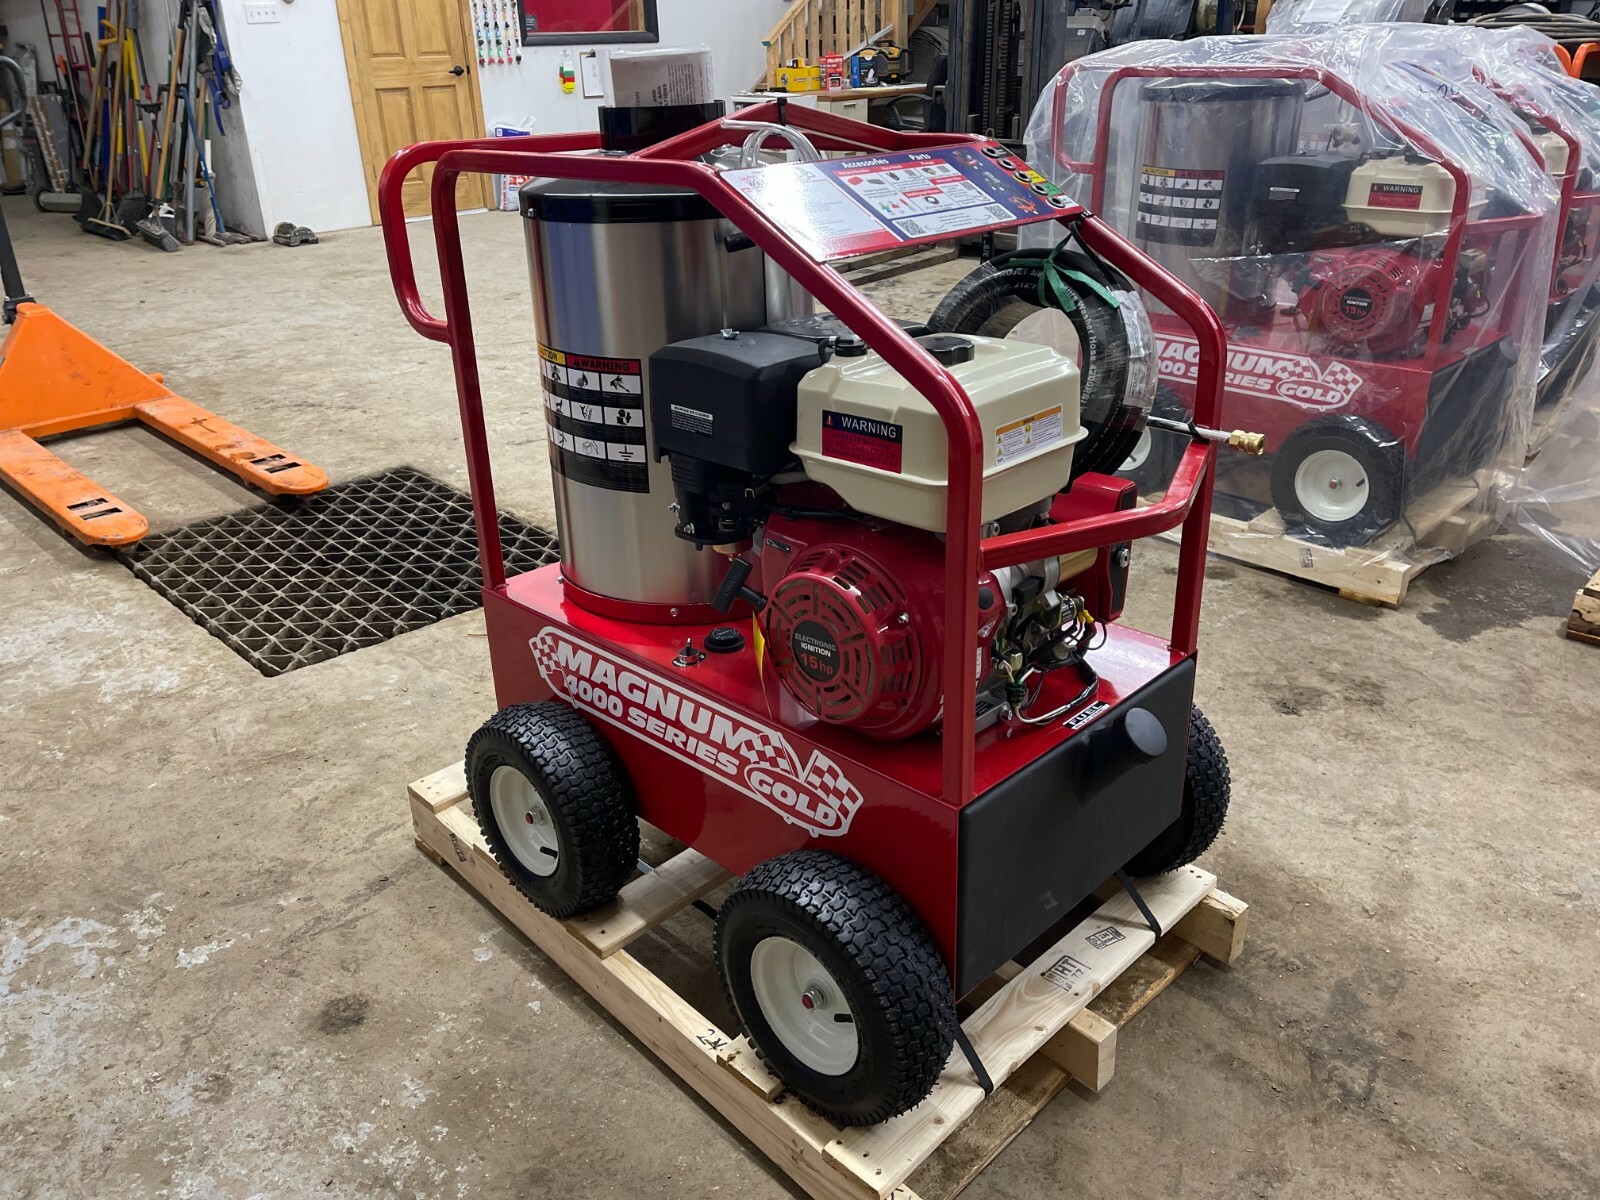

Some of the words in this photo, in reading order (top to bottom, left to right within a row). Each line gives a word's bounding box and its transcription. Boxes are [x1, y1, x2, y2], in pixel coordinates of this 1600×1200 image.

[842, 158, 889, 168] Accessories
[908, 153, 932, 161] Parts
[1383, 185, 1419, 194] WARNING
[1077, 300, 1094, 334] Washer
[1089, 336, 1097, 361] Hose
[581, 358, 630, 372] WARNING
[1279, 383, 1342, 403] GOLD
[841, 416, 897, 438] WARNING
[795, 632, 837, 651] ELECTRONIC
[800, 642, 831, 657] IGNITION
[557, 640, 758, 755] MAGNUM
[565, 674, 623, 718] 4000
[627, 706, 740, 775] SERIES
[1069, 704, 1103, 726] FUEL
[750, 770, 837, 827] GOLD
